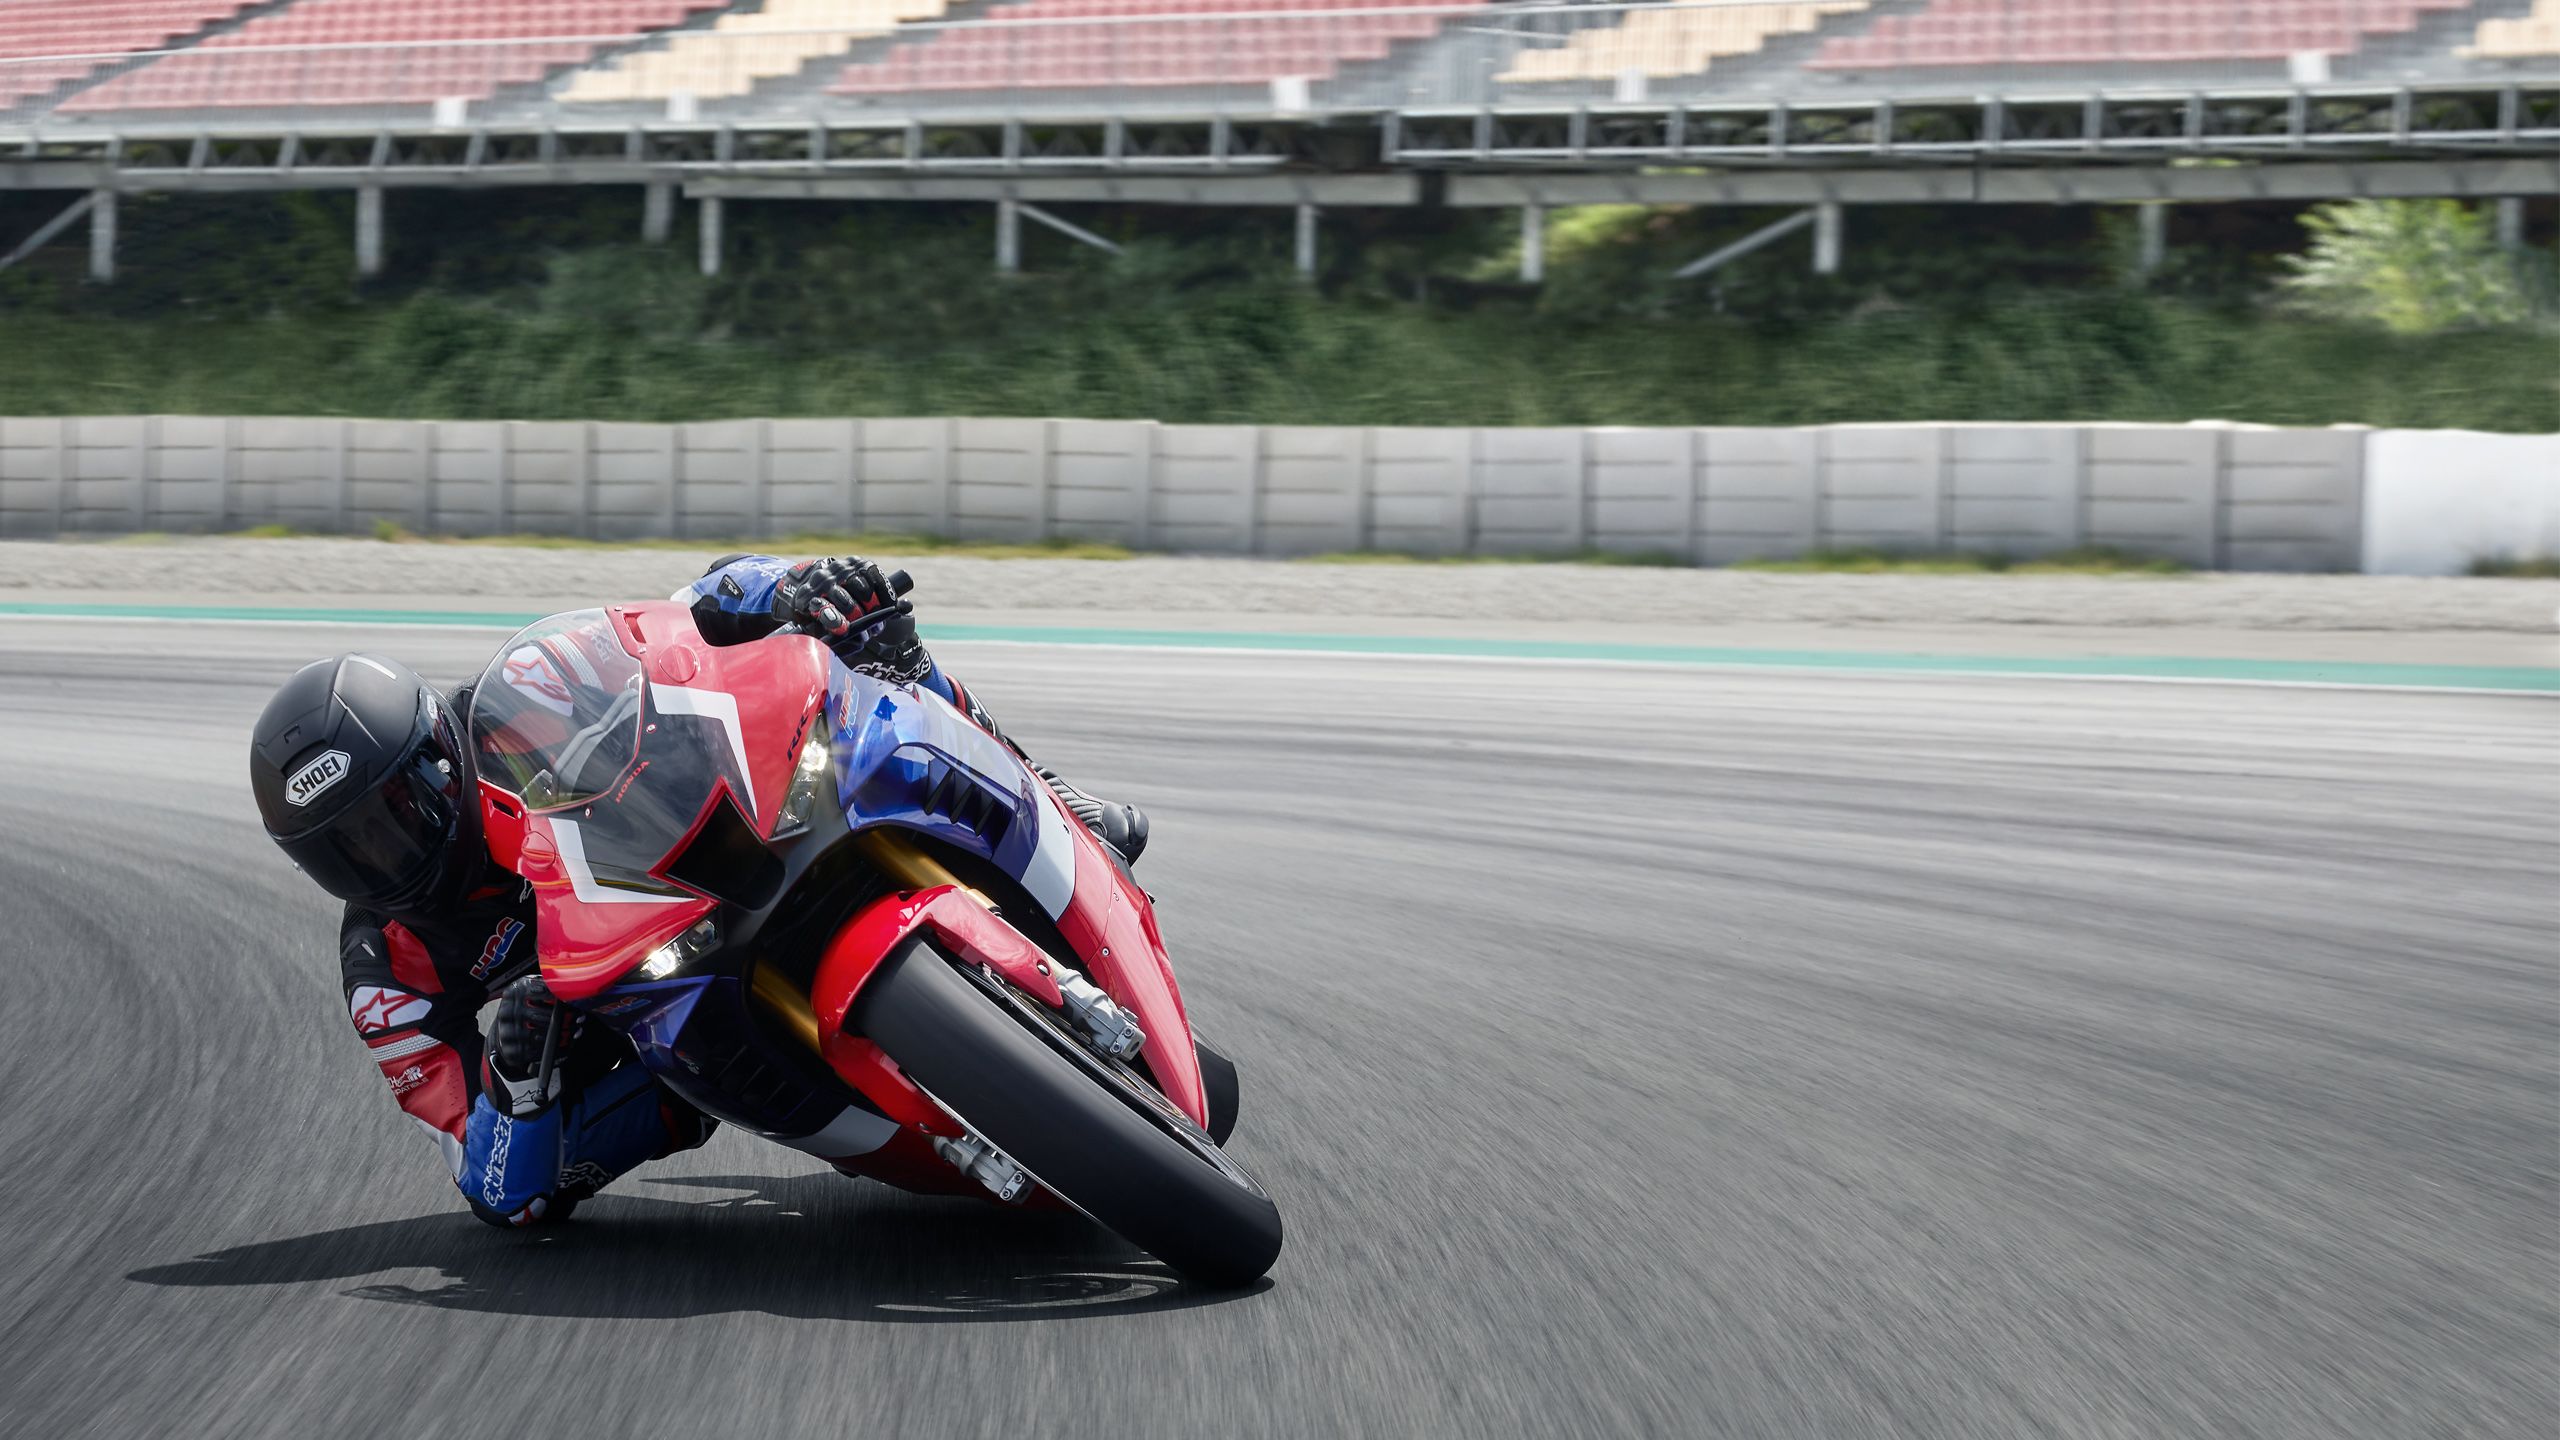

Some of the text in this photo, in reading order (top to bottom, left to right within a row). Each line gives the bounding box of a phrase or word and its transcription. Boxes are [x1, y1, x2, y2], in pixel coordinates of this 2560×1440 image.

[292, 756, 342, 800] SHOEI
[615, 761, 650, 803] HONDA
[469, 916, 526, 981] HRC
